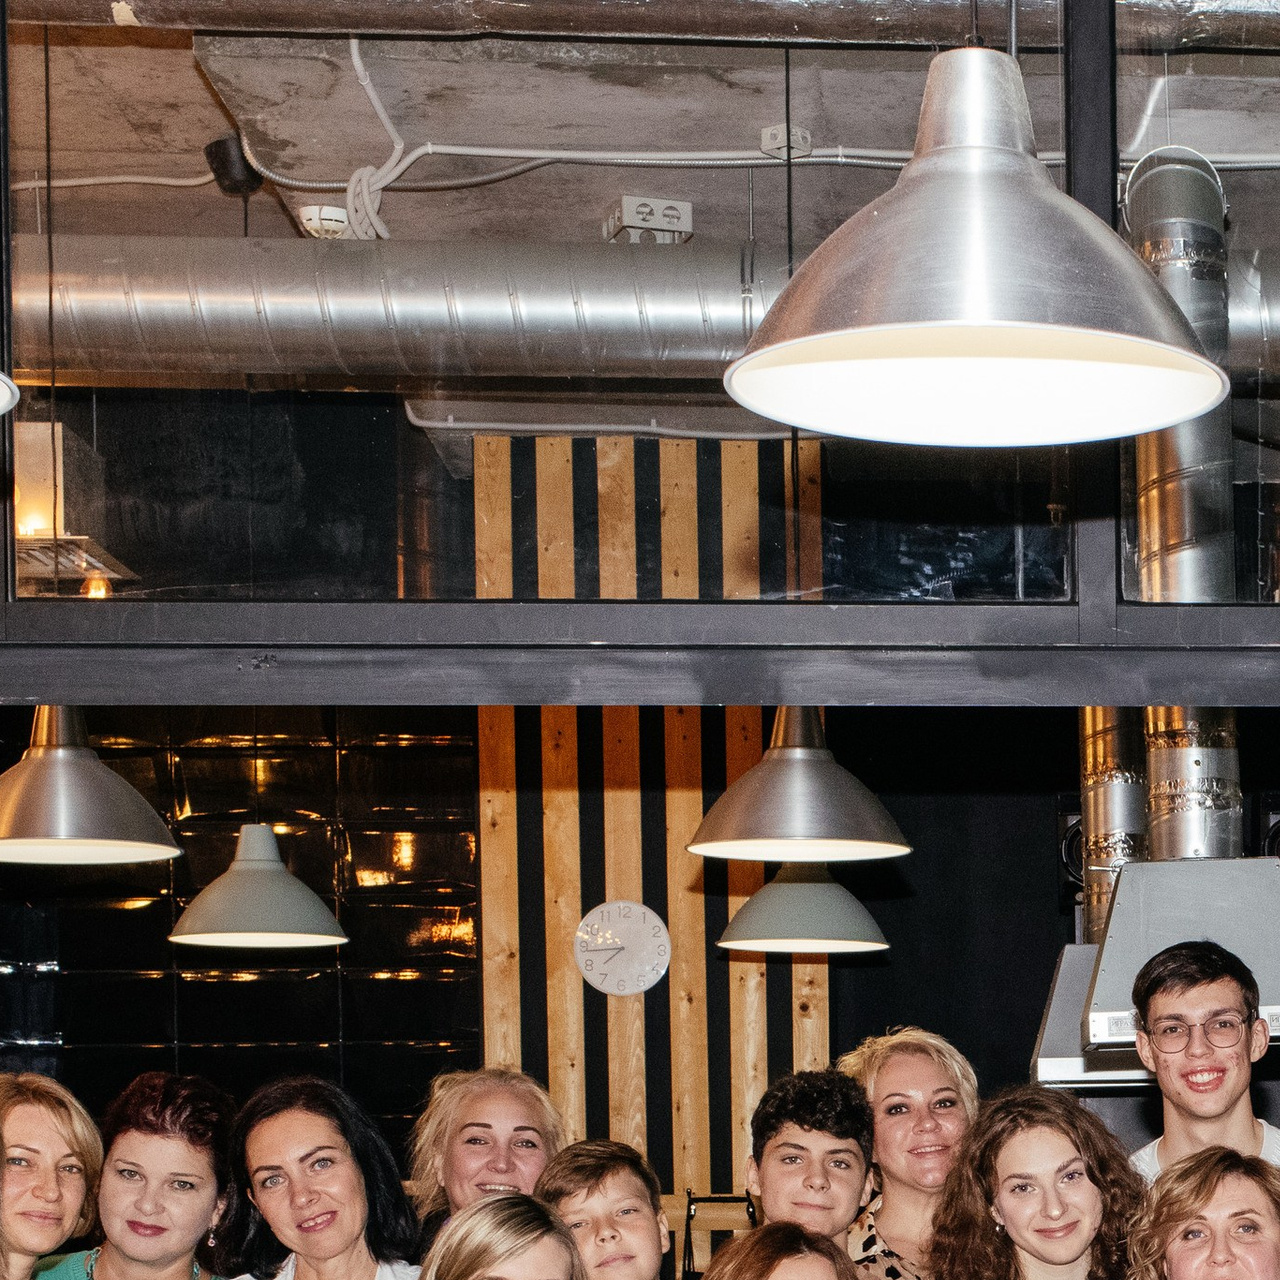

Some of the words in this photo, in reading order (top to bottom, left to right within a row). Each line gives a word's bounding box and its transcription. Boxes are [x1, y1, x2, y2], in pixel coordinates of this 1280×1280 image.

[600, 910, 611, 922] 11
[617, 905, 632, 919] 12
[642, 911, 647, 924] 1
[652, 925, 662, 938] 2
[579, 940, 589, 953] 9
[657, 944, 667, 957] 3
[584, 959, 594, 972] 8
[599, 972, 608, 986] 7
[616, 979, 626, 992] 6
[636, 974, 646, 988] 5
